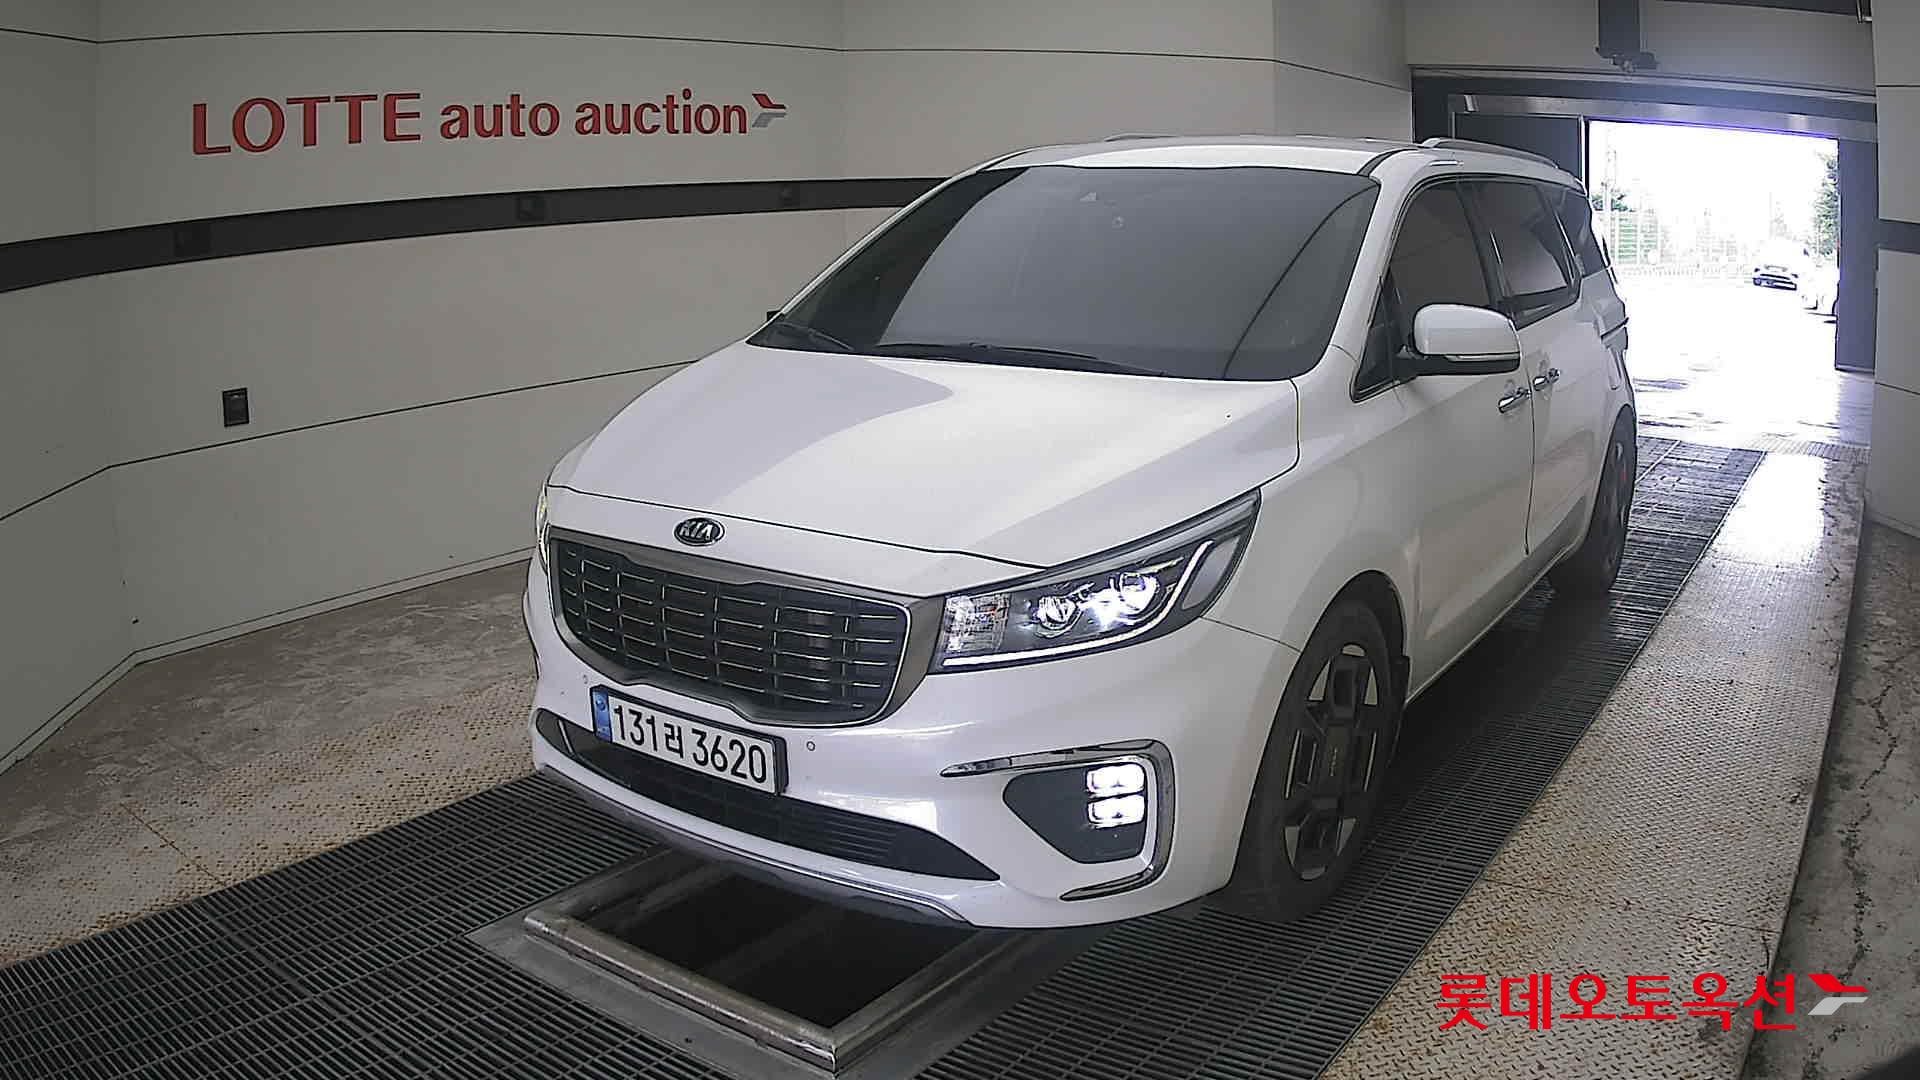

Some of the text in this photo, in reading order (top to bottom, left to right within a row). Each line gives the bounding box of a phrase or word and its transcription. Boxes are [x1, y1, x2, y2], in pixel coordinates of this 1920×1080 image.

[192, 88, 748, 155] LOTTE auto auction
[677, 520, 715, 542] KIA
